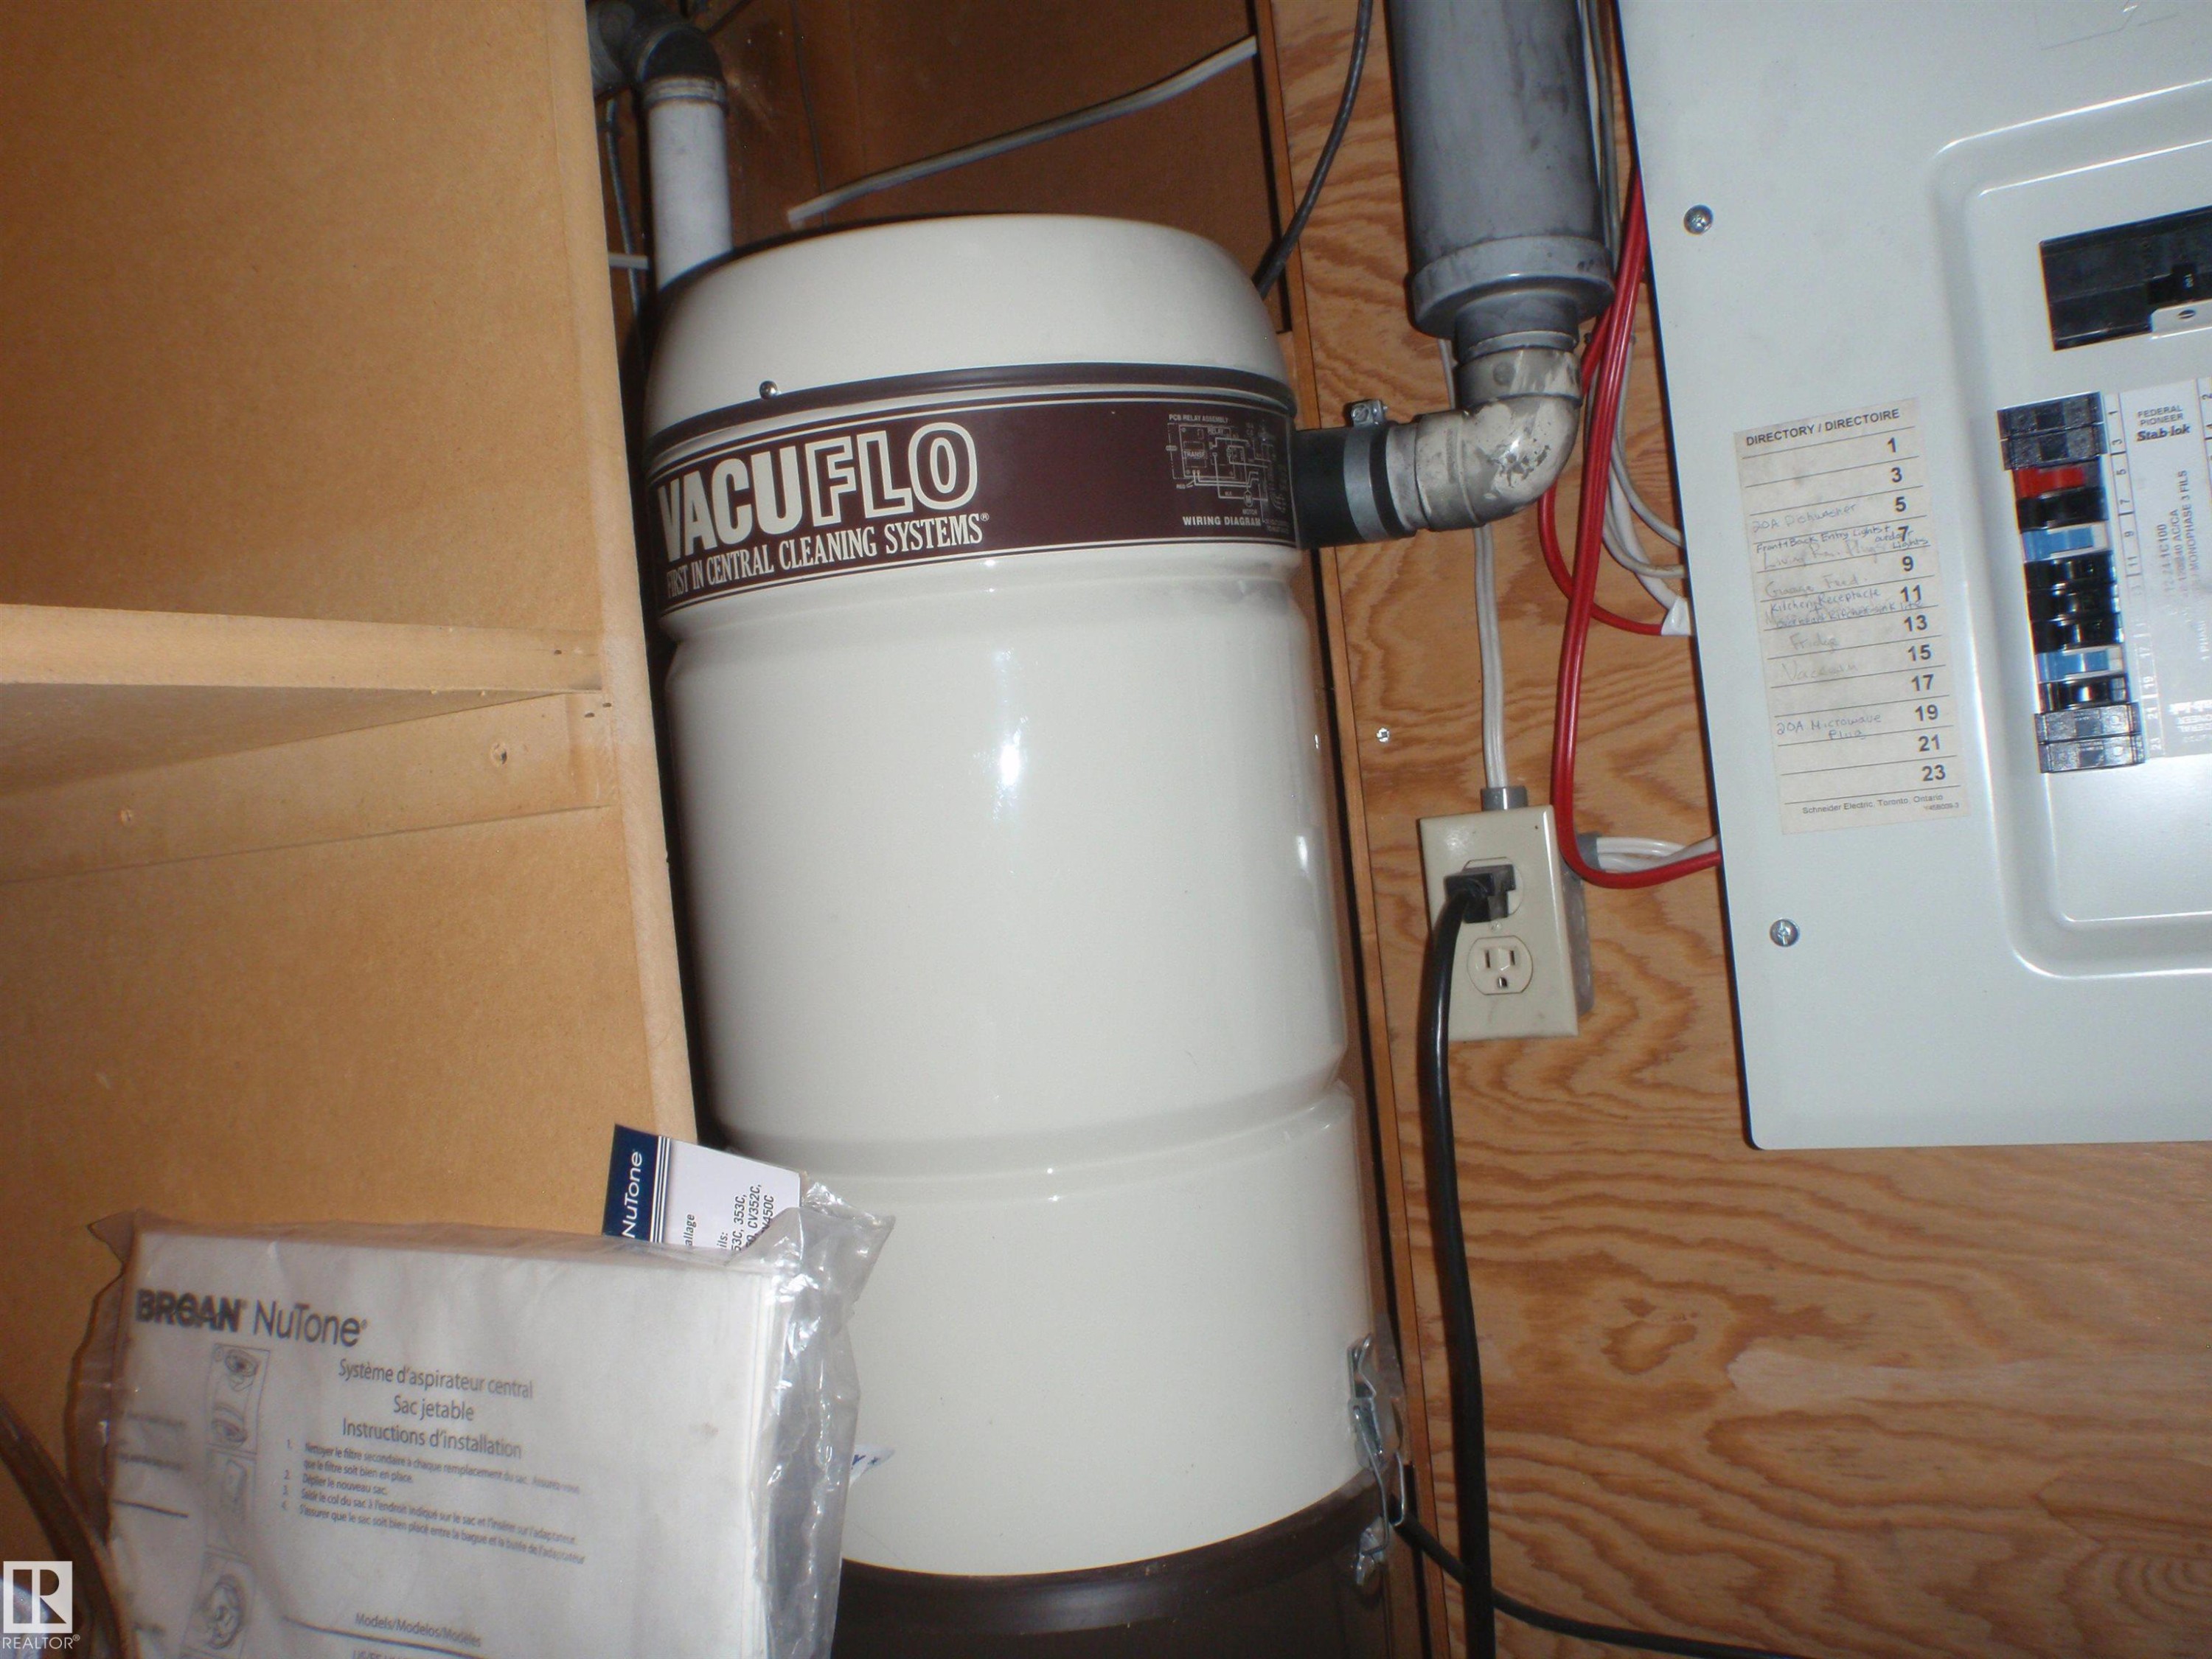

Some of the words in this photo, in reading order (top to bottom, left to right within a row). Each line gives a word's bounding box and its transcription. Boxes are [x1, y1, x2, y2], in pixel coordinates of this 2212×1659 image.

[2138, 405, 2183, 419] FEDERAL
[2140, 413, 2183, 426] PIONEER
[1747, 425, 1815, 446] DIRECTORY
[1825, 408, 1900, 432] DIRECTOIRE
[1888, 437, 1897, 453] 1
[1891, 467, 1903, 483] 3
[2178, 470, 2189, 493] FILS
[658, 422, 978, 563] VACUFLO
[2121, 497, 2130, 505] 7
[1895, 496, 1907, 512] 5
[1183, 516, 1221, 526] WIRING
[1224, 517, 1262, 526] DIAGRAM
[1898, 526, 1910, 542] 7
[2183, 503, 2200, 570] MONOPHASE
[692, 560, 705, 590] IN
[706, 546, 774, 588] CENTRAL
[779, 526, 877, 569] CLEANING
[1902, 556, 1914, 572] 9
[2127, 556, 2138, 568] 11
[1899, 585, 1922, 603] 11
[1904, 614, 1928, 632] 13
[1907, 644, 1932, 661] 15
[1911, 674, 1935, 692] 17
[1915, 704, 1939, 722] 19
[1918, 734, 1941, 752] 21
[1921, 764, 1947, 782] 23
[1802, 804, 1841, 814] Schneider
[1913, 793, 1944, 803] Ontario
[622, 1152, 643, 1239] NuTone
[734, 1194, 748, 1226] 353C,
[748, 1183, 762, 1230] CV352C,
[685, 1214, 696, 1246] allage
[338, 1358, 394, 1384] Système
[396, 1366, 484, 1394] d'aspirateur
[487, 1378, 534, 1399] central
[393, 1395, 417, 1415] Sac
[420, 1398, 475, 1422] jetable
[342, 1418, 425, 1447] Instructions
[428, 1428, 523, 1460] d'installation
[335, 1447, 342, 1458] le
[364, 1453, 406, 1467] secondaire
[413, 1458, 442, 1472] chaque
[336, 1480, 372, 1492] nouveau
[327, 1494, 339, 1504] col
[340, 1495, 352, 1506] du
[353, 1499, 366, 1508] sac
[330, 1509, 347, 1523] que
[460, 1530, 489, 1545] bague
